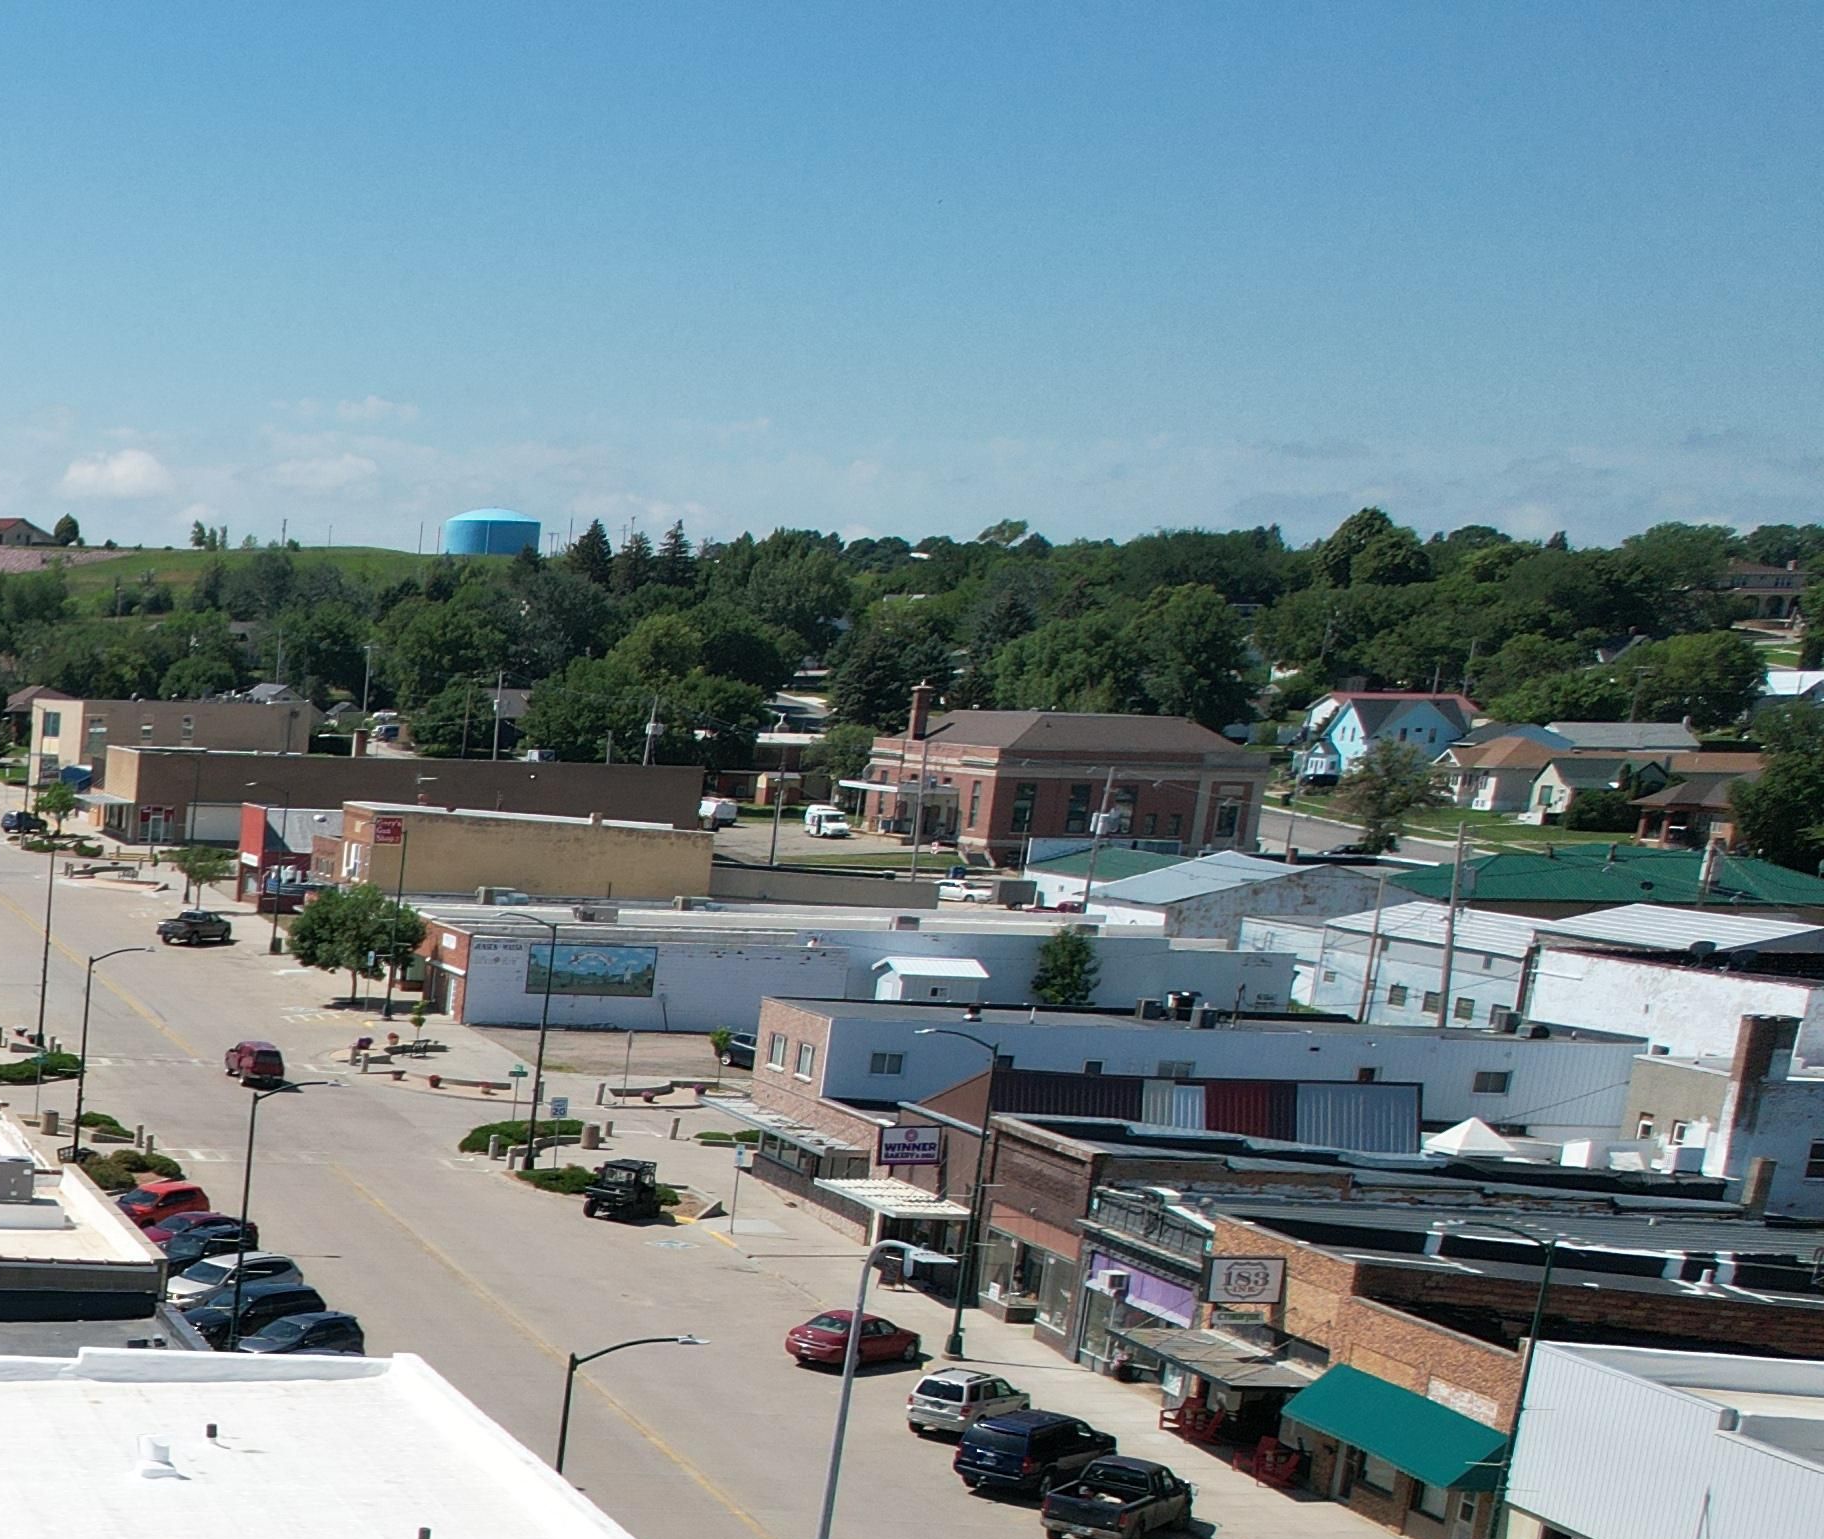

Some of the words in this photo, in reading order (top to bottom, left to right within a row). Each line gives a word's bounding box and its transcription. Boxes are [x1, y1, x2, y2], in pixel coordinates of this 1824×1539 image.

[552, 1107, 567, 1116] 20
[884, 1142, 937, 1152] WINNER
[1223, 1270, 1270, 1287] 183
